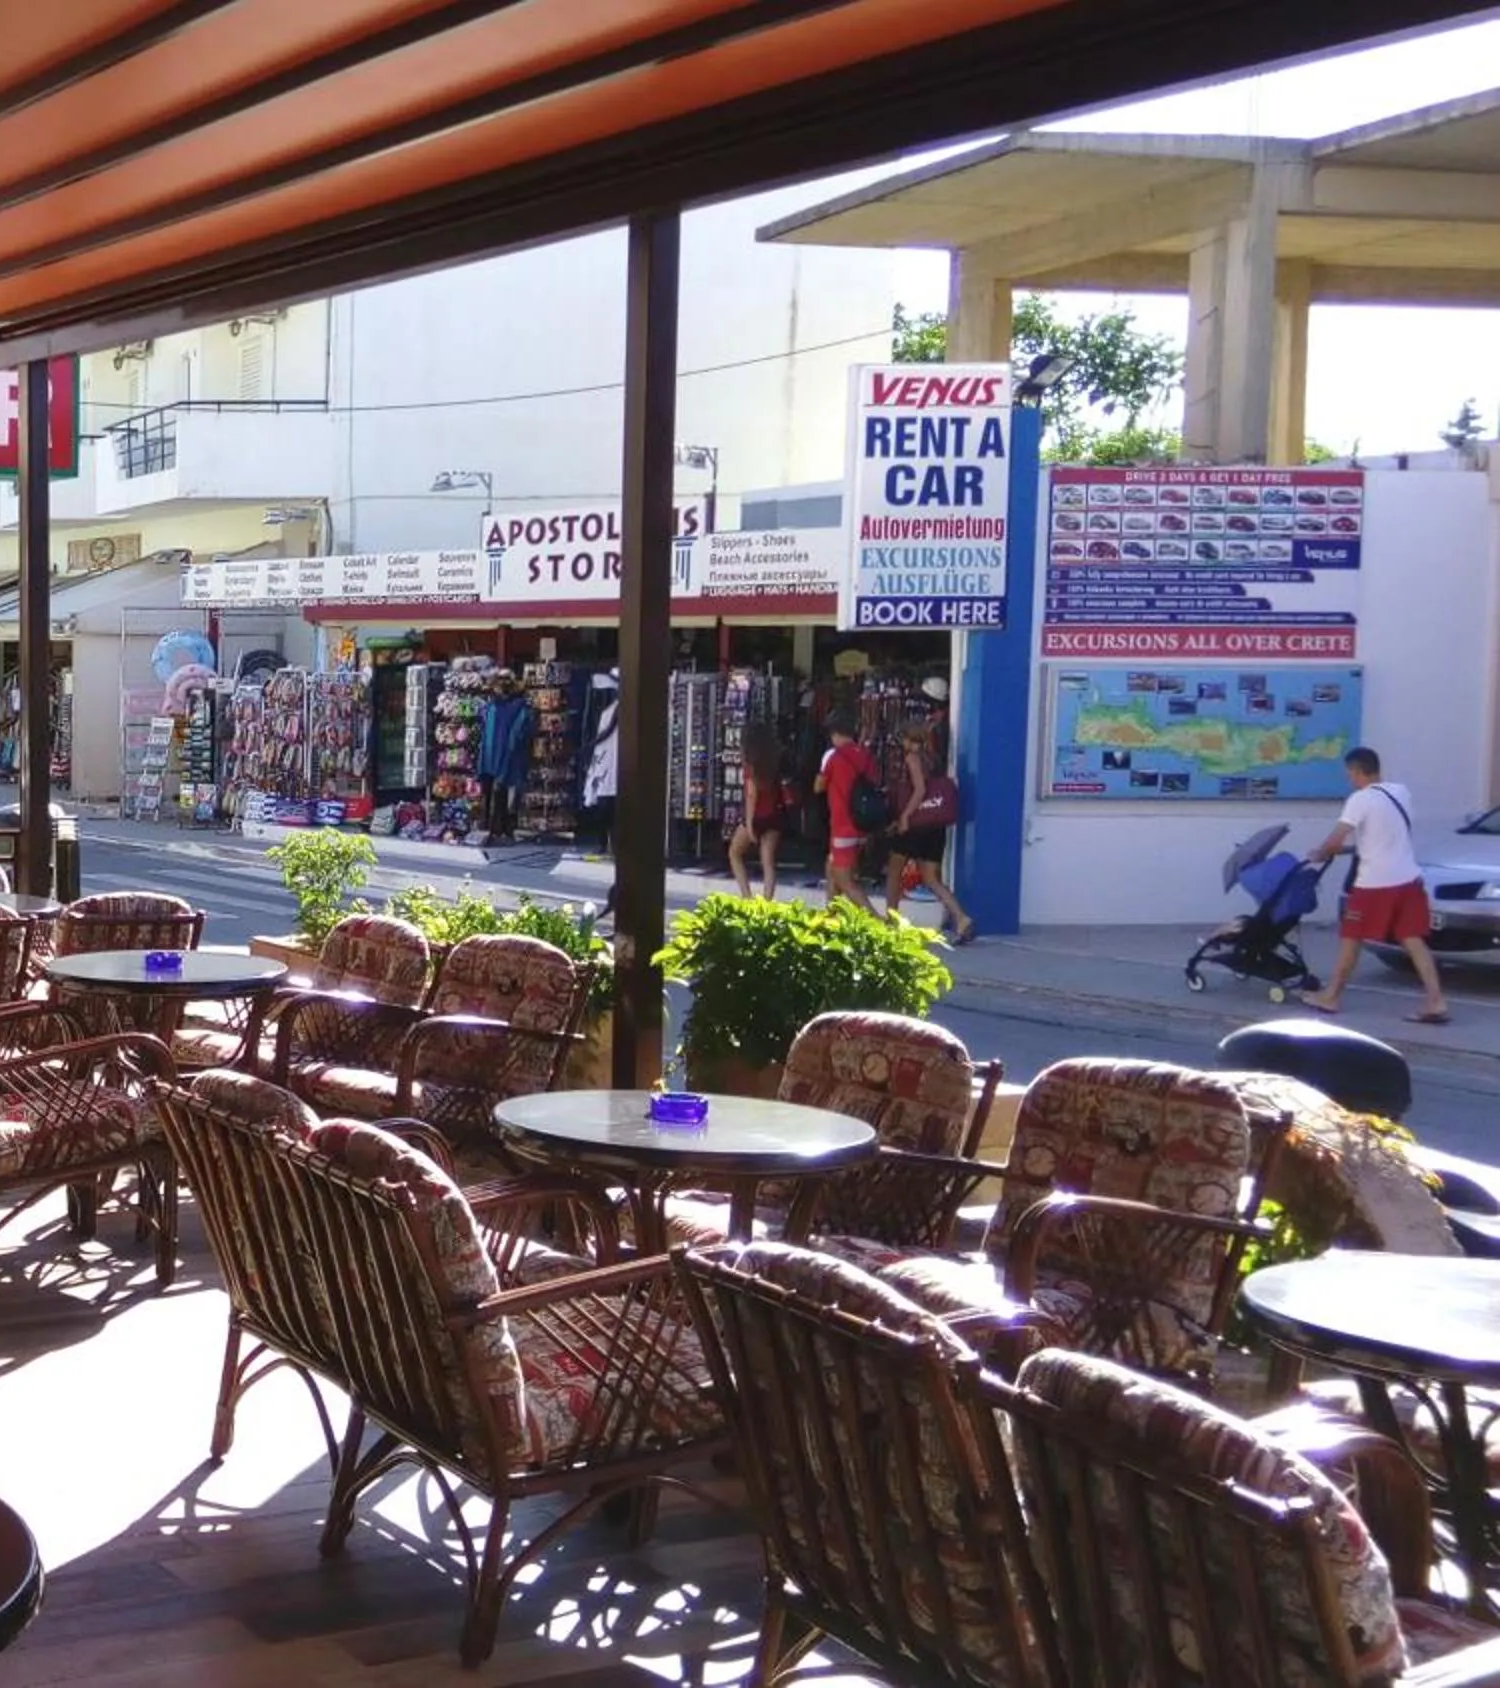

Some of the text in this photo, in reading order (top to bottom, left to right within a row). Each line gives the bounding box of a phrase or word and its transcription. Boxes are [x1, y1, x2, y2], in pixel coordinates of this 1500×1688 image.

[872, 373, 1003, 408] VENUS
[865, 417, 1005, 458] RENT A
[885, 464, 984, 507] CAR
[1125, 472, 1156, 482] DRIVE
[1169, 472, 1196, 482] DAYS
[486, 506, 699, 547] APOSTOLIS
[860, 514, 1005, 541] Autovermietung
[711, 535, 752, 550] Slippers
[762, 534, 796, 547] Shoes
[528, 552, 621, 584] STOR
[710, 550, 809, 565] Beach Accessories
[861, 546, 1002, 570] EXCURSIONS
[871, 569, 991, 595] AUSFLÜGE
[860, 601, 1000, 625] BOOK HERE
[1047, 632, 1351, 651] EXCURSIONS ALL OVER CRETE
